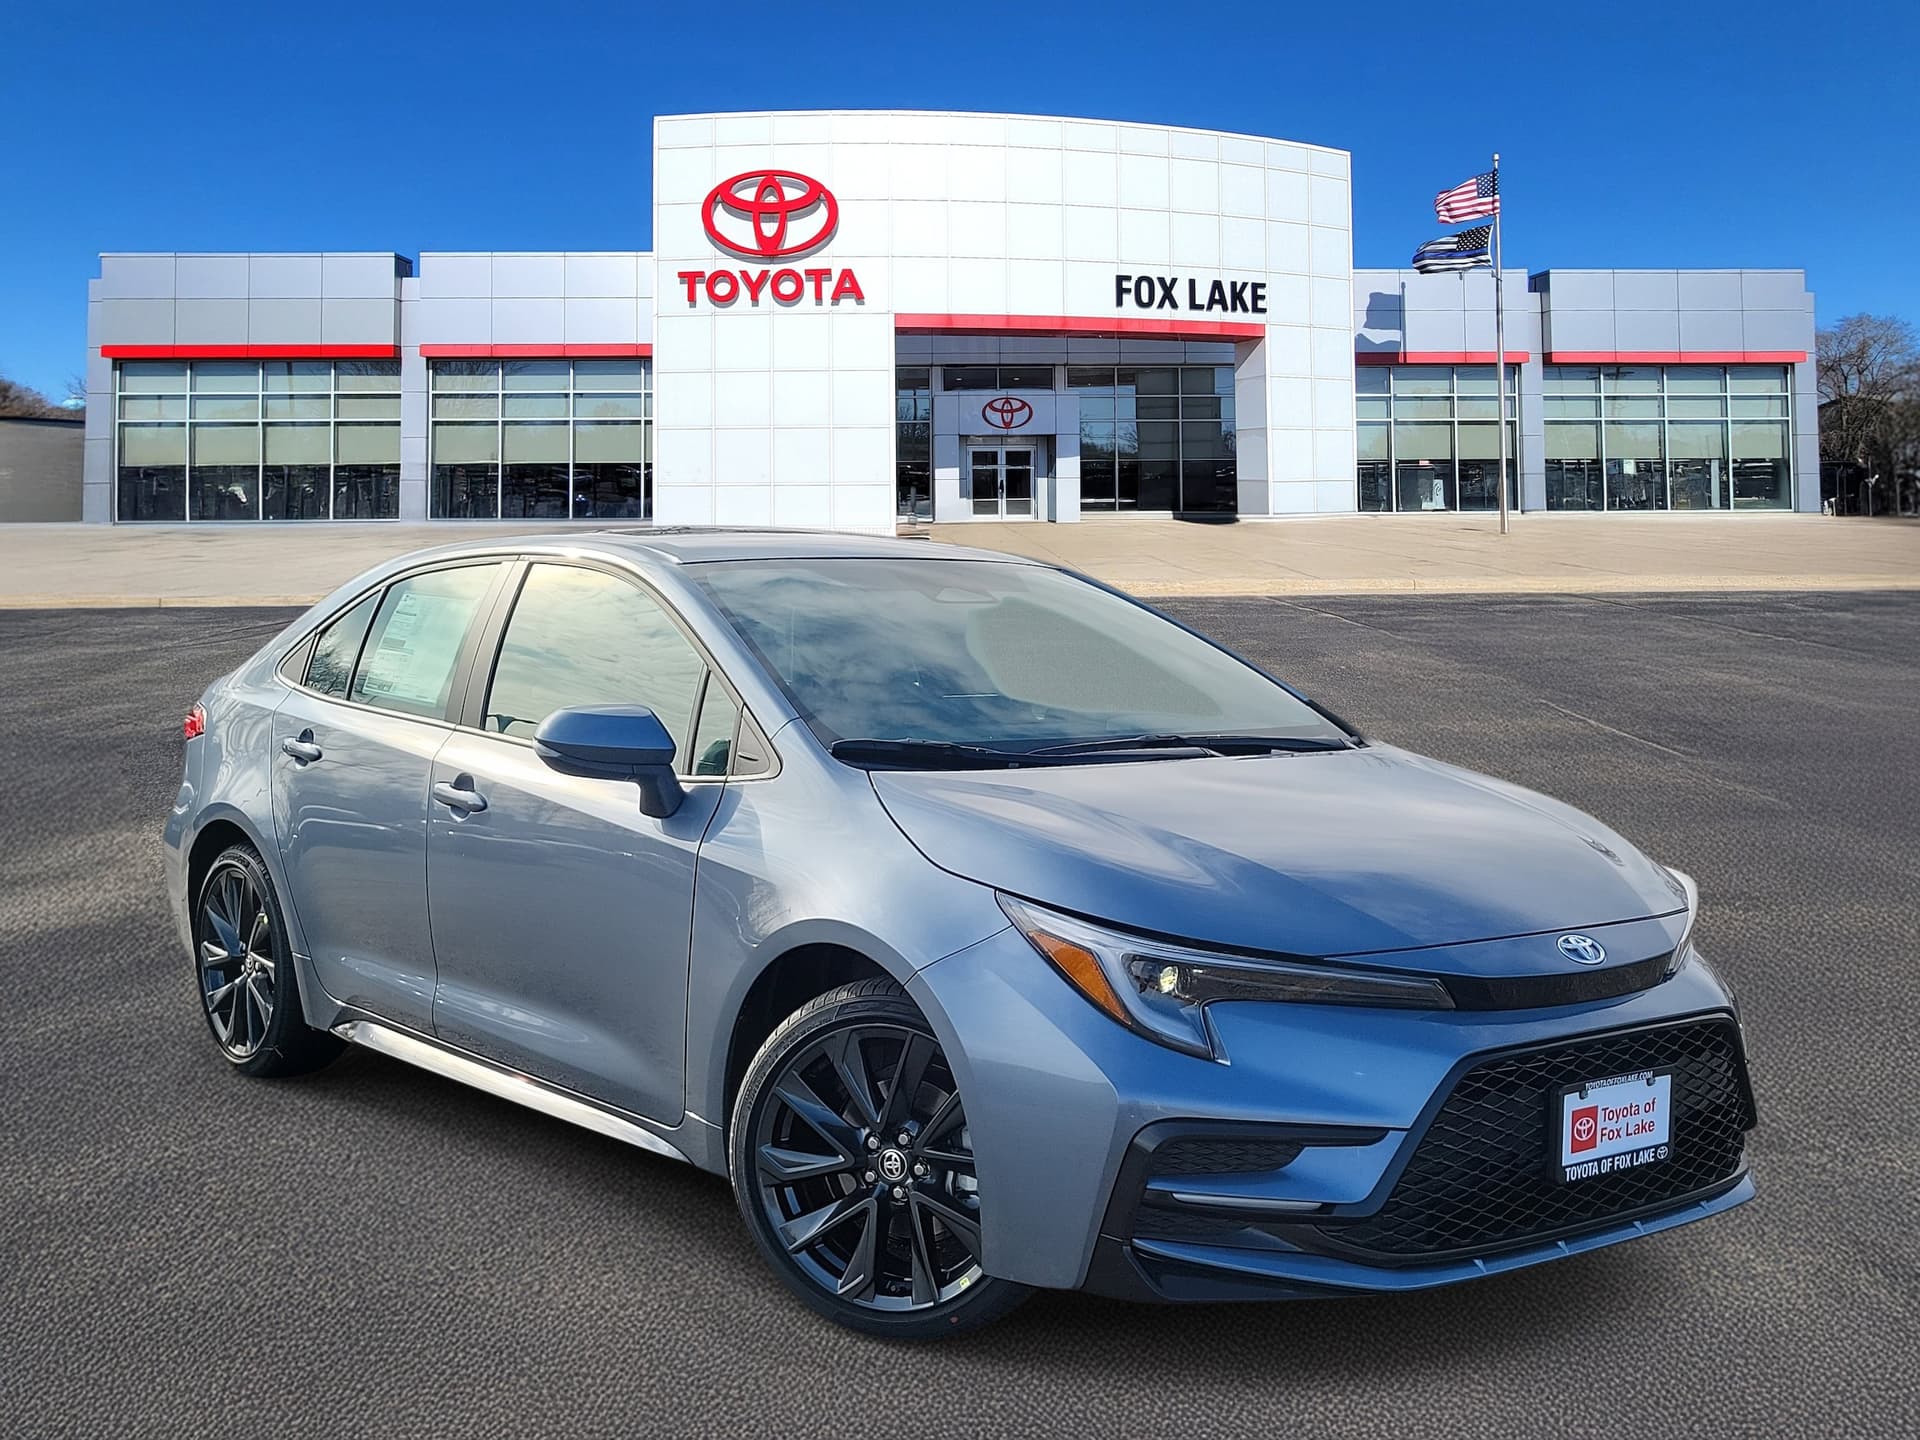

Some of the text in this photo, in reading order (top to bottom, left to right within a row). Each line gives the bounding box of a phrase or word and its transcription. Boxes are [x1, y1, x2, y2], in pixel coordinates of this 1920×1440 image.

[678, 268, 865, 308] TOYOTA
[1115, 274, 1268, 314] FOX LAKE
[1601, 1097, 1656, 1124] Toyota of
[1600, 1119, 1655, 1143] Fox Lake
[1565, 1148, 1656, 1182] TOYOTA OF FOX LAKE
